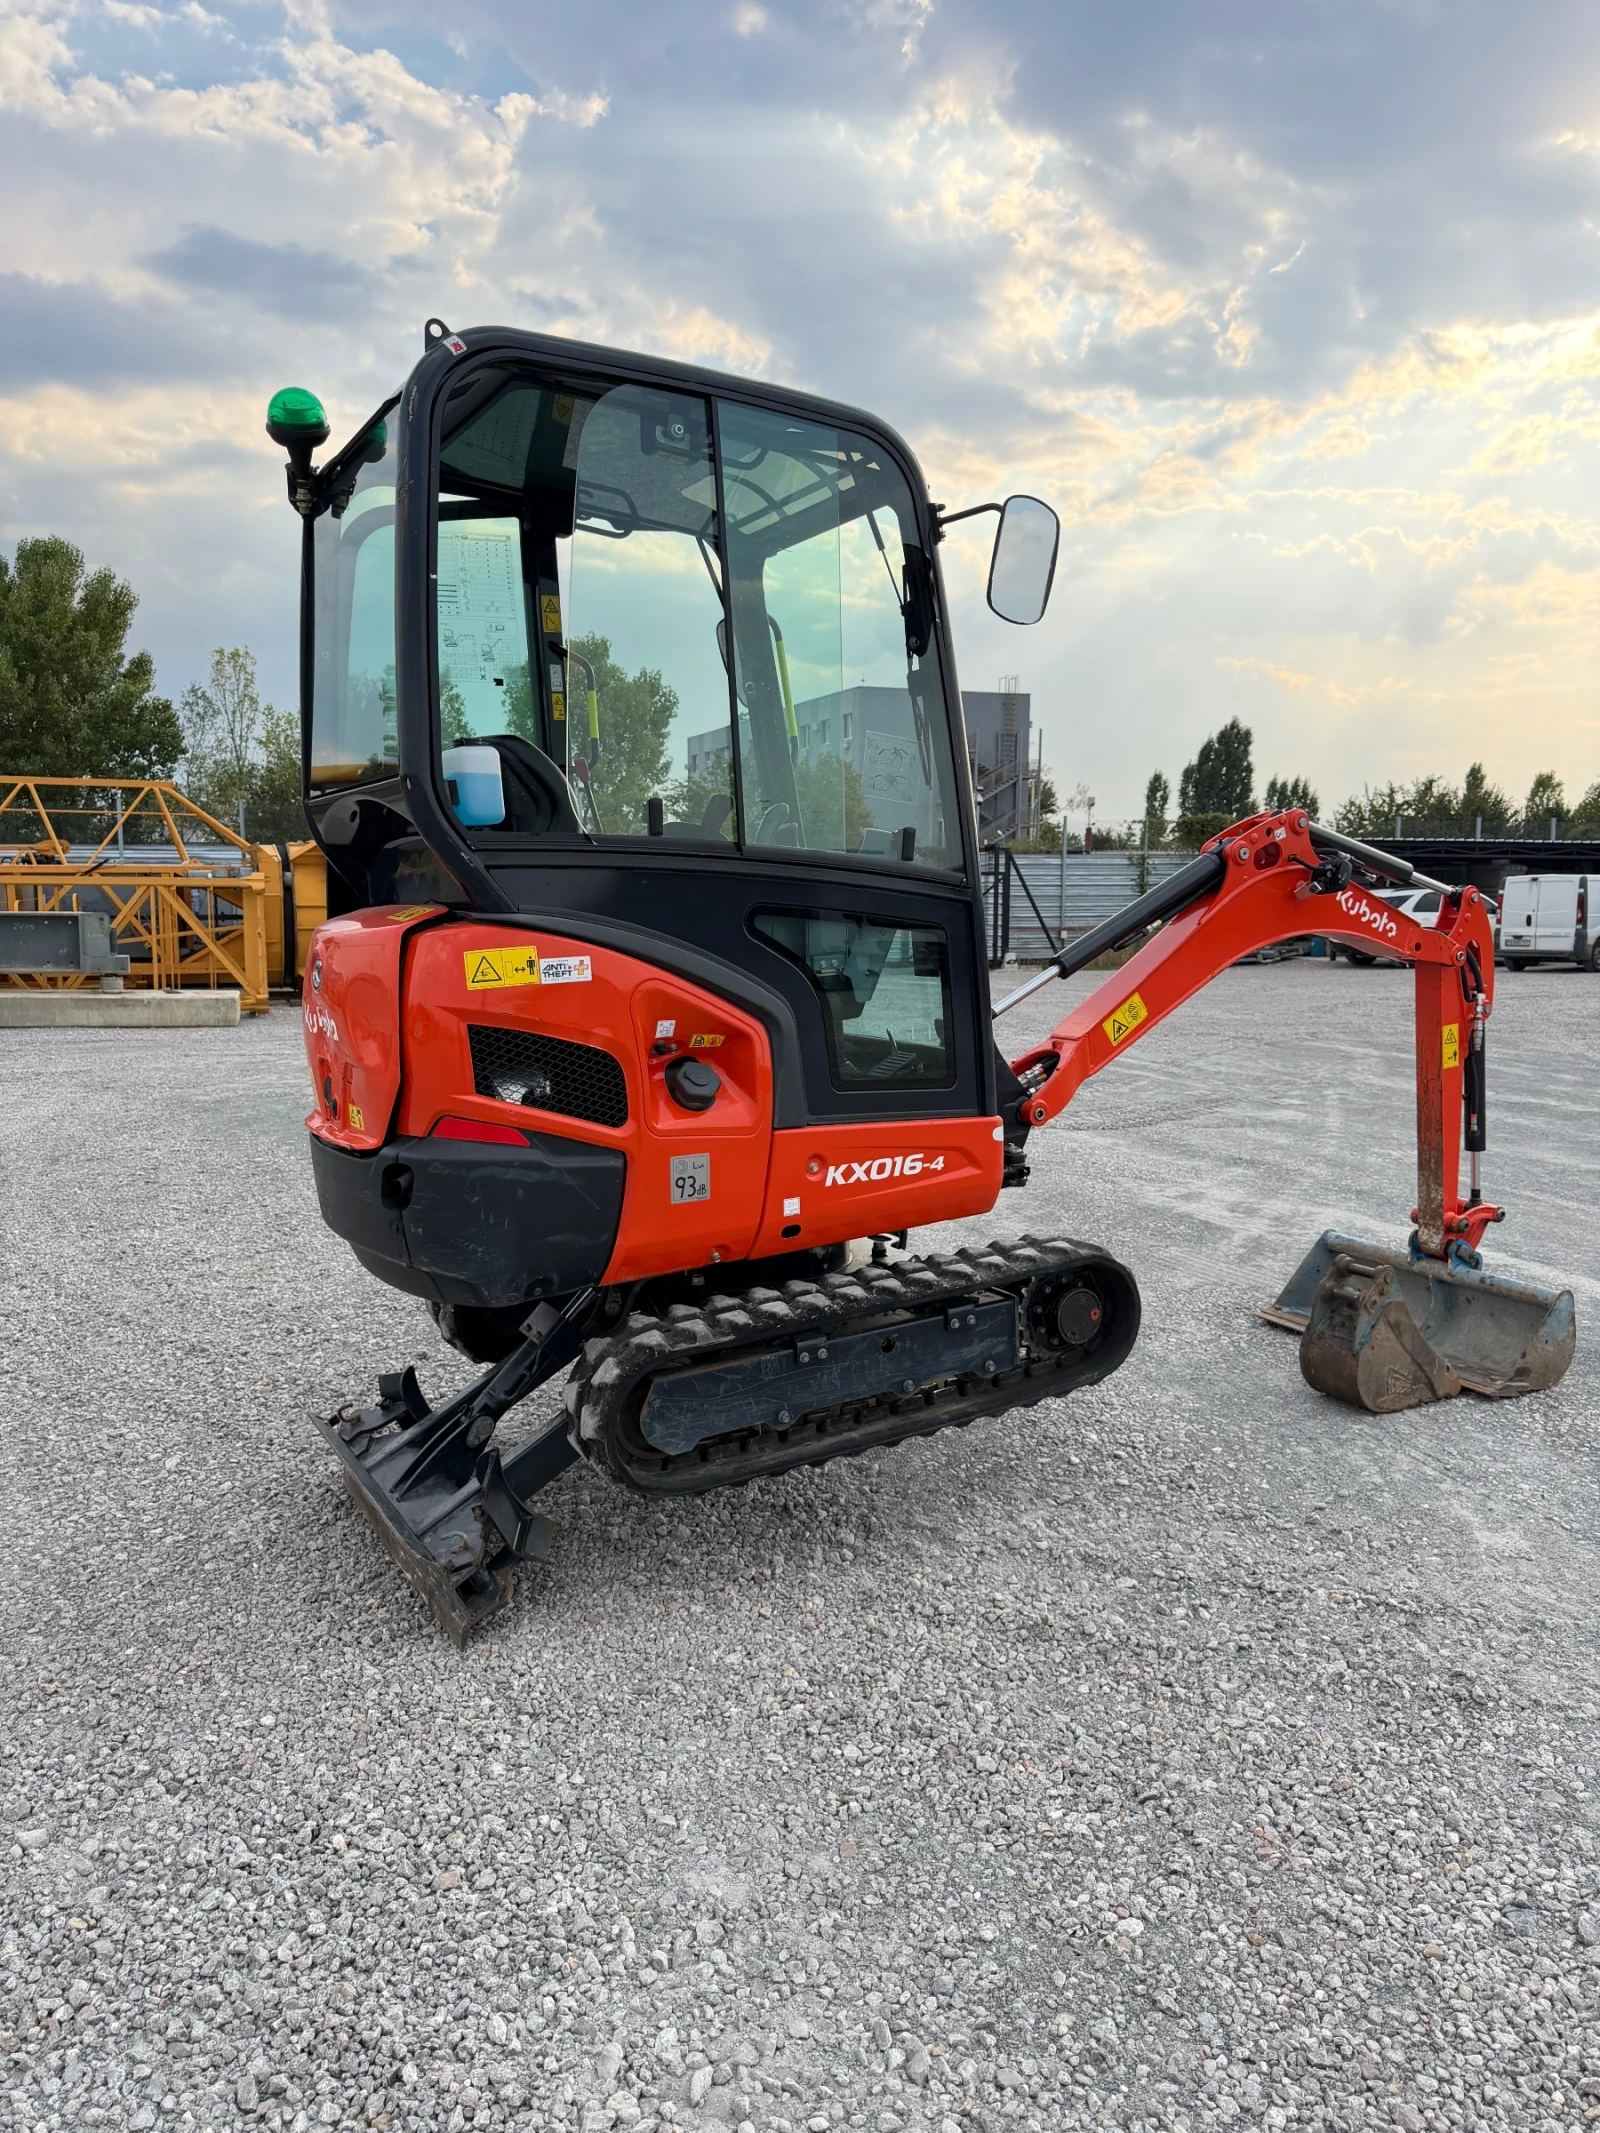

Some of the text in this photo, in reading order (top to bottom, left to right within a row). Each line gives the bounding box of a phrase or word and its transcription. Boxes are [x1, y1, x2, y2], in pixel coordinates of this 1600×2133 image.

[1336, 891, 1398, 937] Kubota
[542, 970, 572, 978] THEFT
[543, 963, 566, 972] ANTI
[825, 1153, 945, 1187] KX016-4
